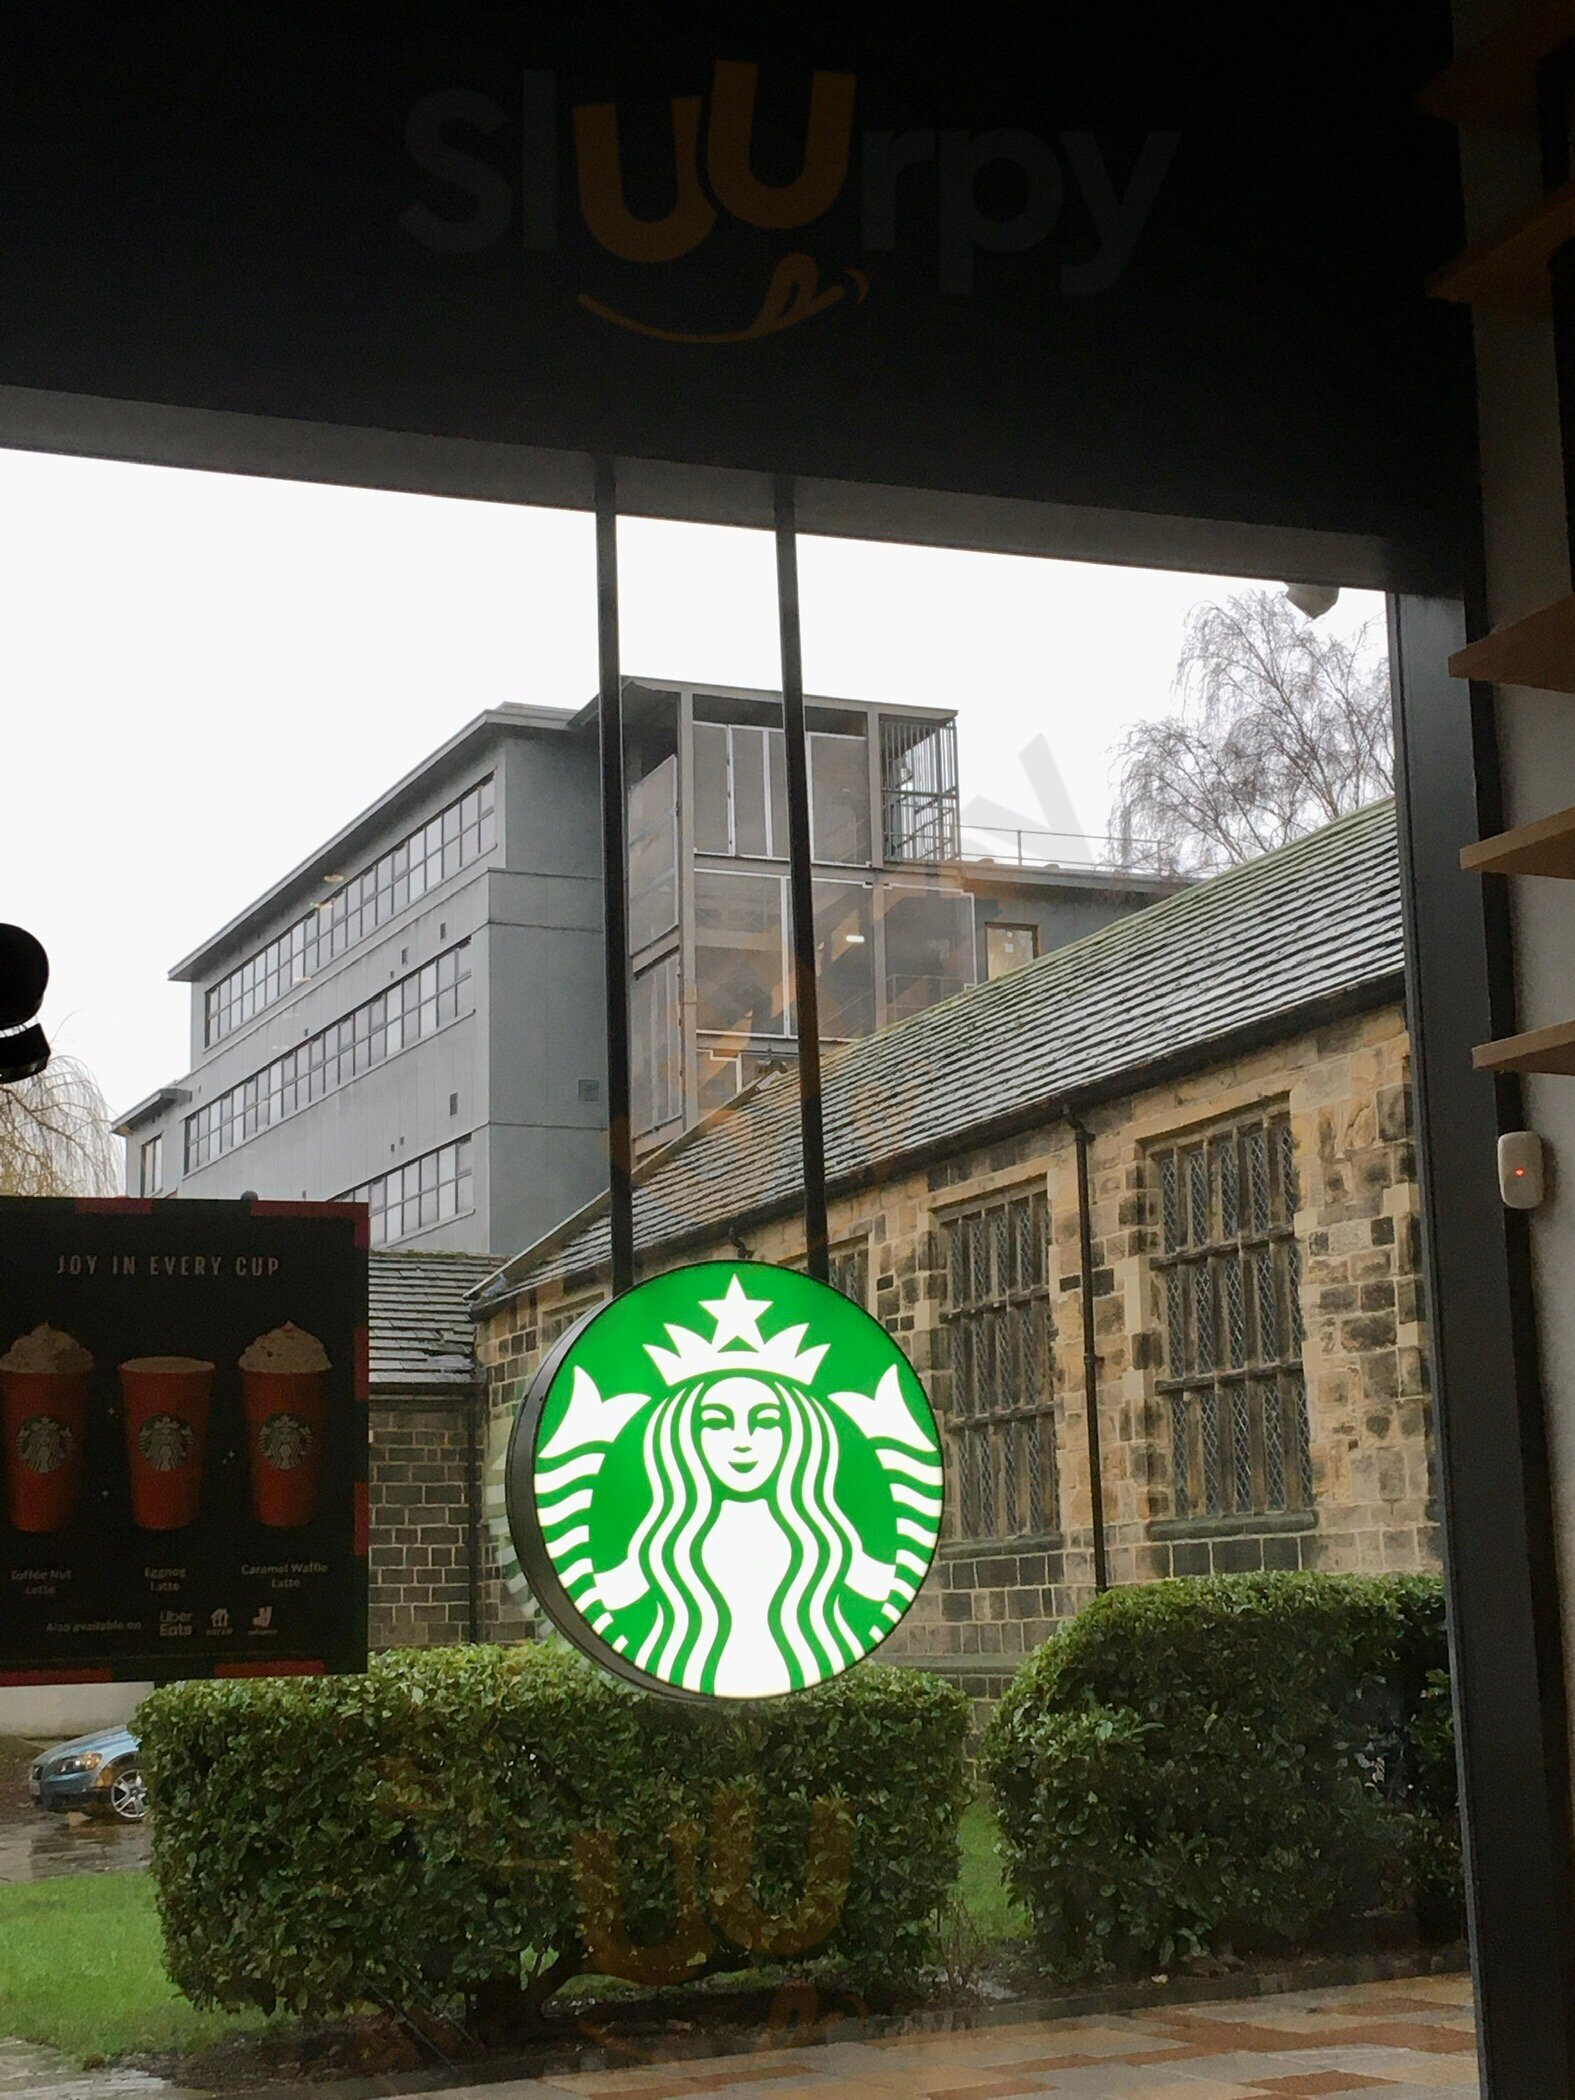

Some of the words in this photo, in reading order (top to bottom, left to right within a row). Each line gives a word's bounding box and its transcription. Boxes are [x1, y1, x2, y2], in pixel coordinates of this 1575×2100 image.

[57, 1254, 98, 1275] JOY
[113, 1255, 136, 1275] IN
[150, 1255, 222, 1276] EVERY
[235, 1256, 280, 1276] CUP
[241, 1564, 289, 1575] Caramel
[291, 1562, 329, 1574] Waffle
[159, 1610, 194, 1623] Uber
[159, 1623, 193, 1637] Eats
